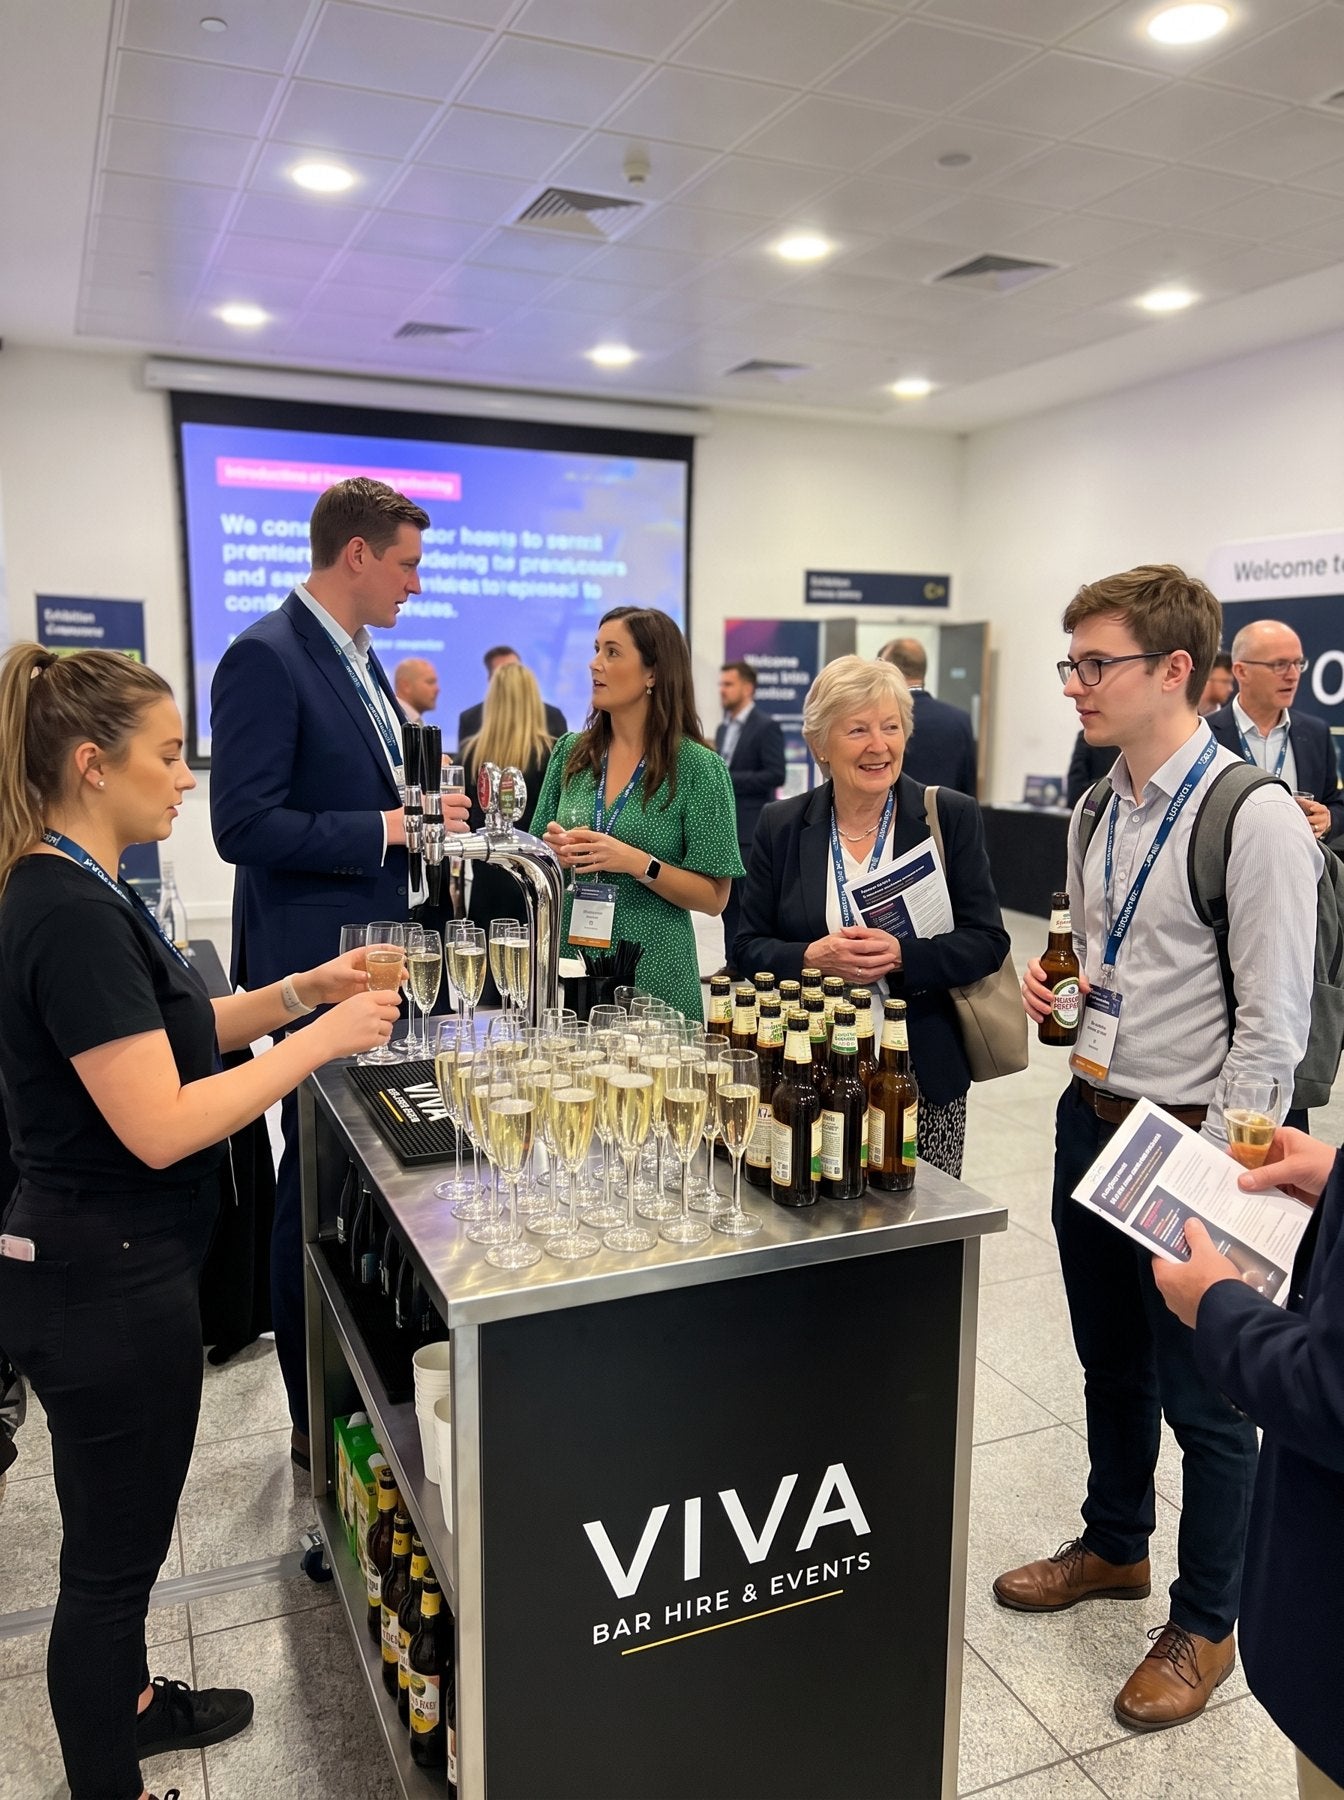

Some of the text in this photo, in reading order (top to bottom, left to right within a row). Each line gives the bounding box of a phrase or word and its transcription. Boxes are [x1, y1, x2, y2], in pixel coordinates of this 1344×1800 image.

[220, 513, 258, 536] We
[223, 566, 266, 588] and
[1233, 554, 1328, 583] Welcome
[582, 1462, 872, 1600] VIVA
[592, 1551, 871, 1646] BAR HIRE & EVENTS
